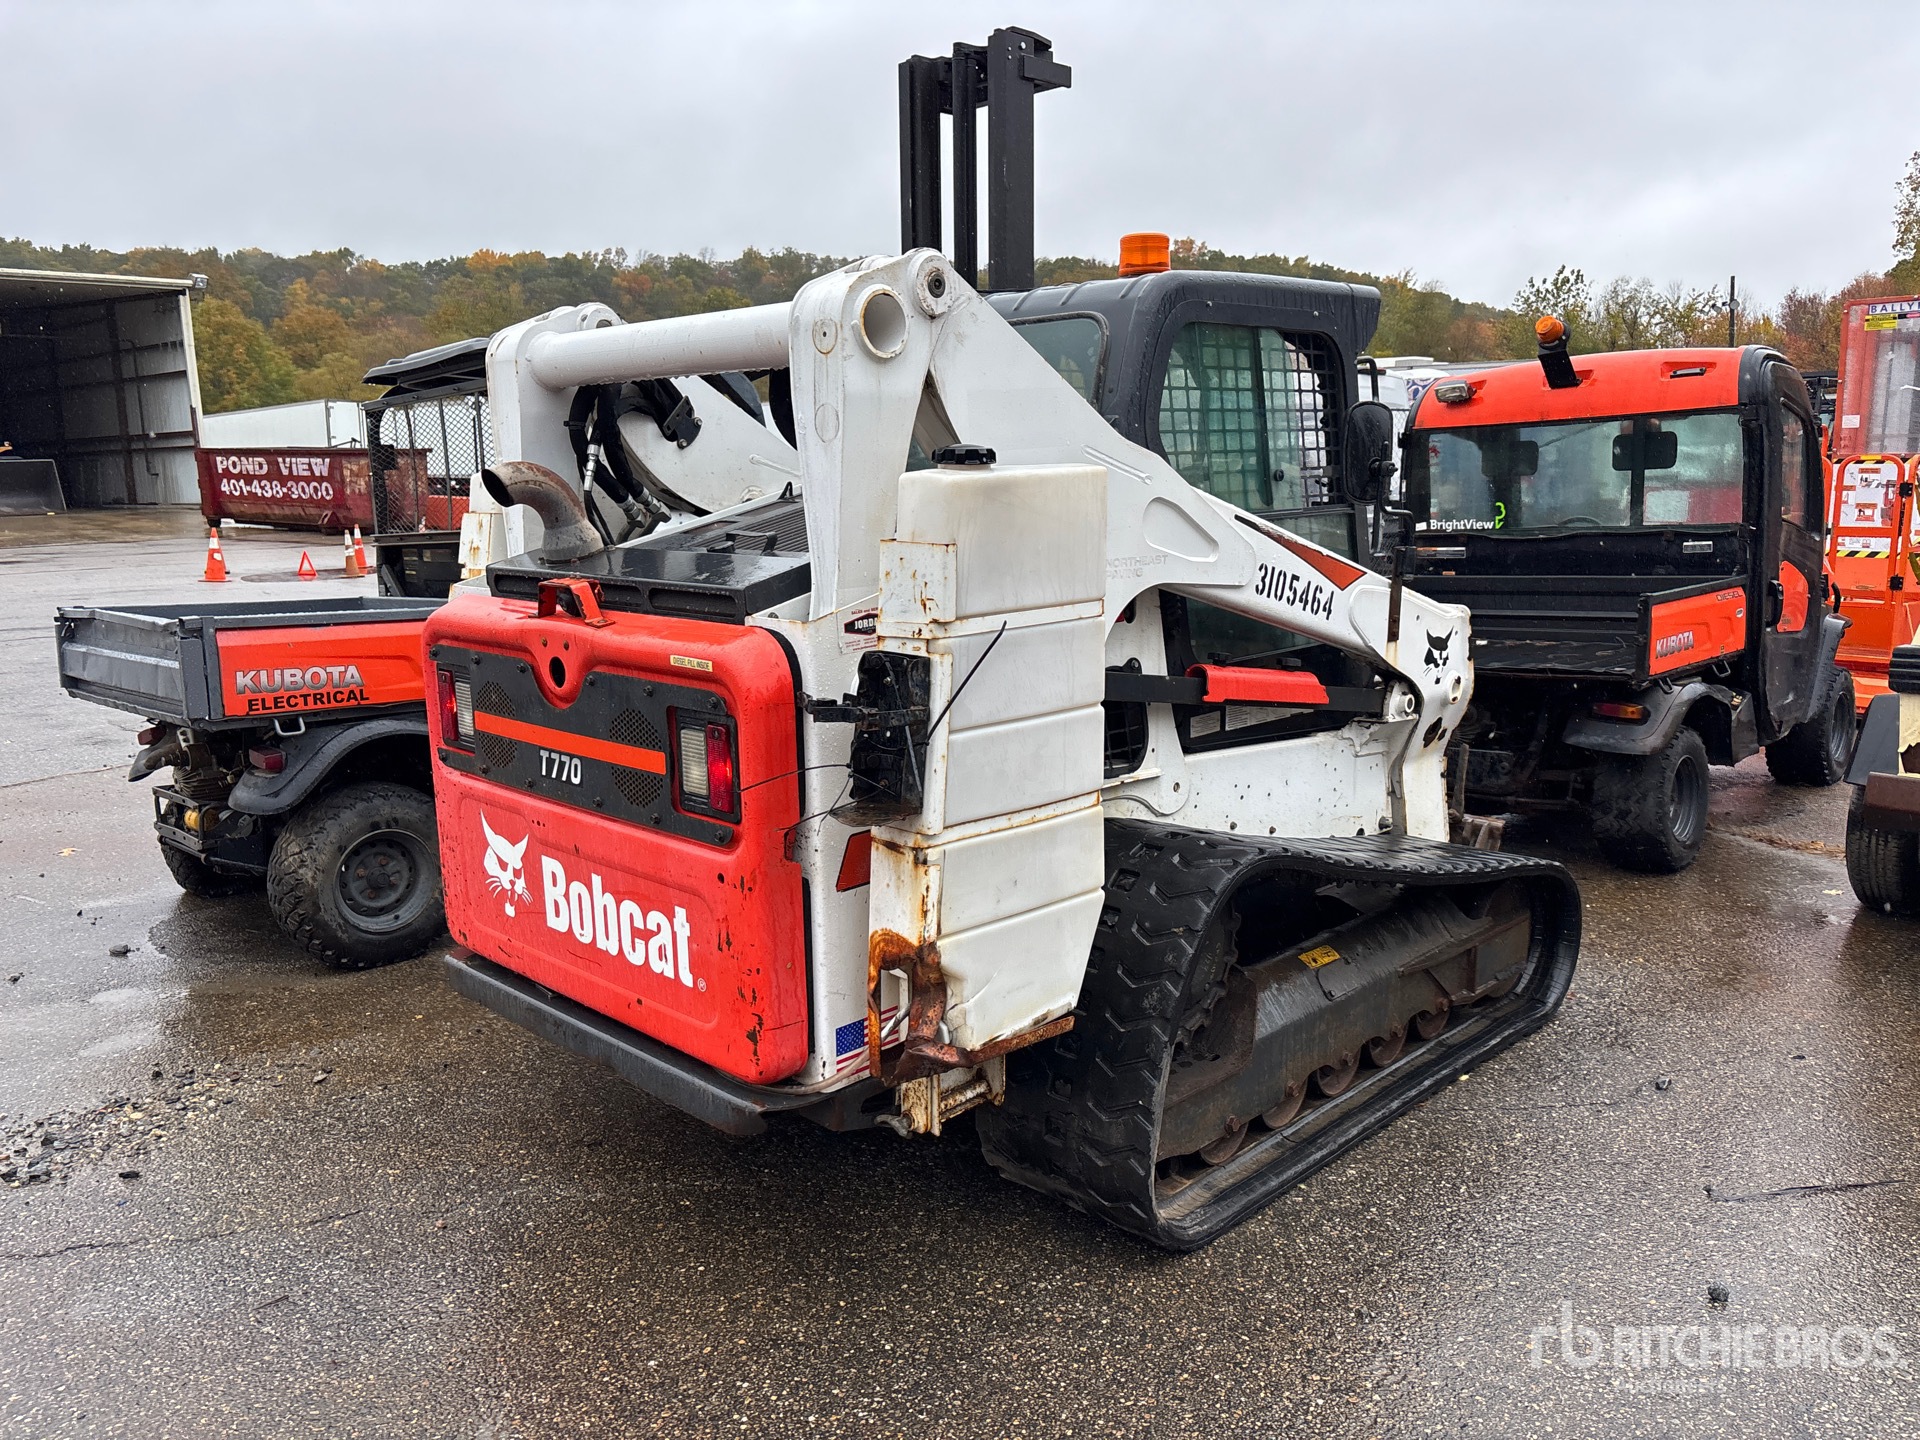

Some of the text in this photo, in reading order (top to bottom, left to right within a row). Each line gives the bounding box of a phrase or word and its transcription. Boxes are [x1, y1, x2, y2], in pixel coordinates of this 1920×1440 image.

[216, 456, 330, 476] POND VIEW
[221, 478, 334, 500] 401-438-3000
[1430, 519, 1494, 532] BrightView
[1106, 554, 1169, 568] NORTHEAST
[1255, 563, 1334, 621] 3105464
[1716, 591, 1743, 602] DIESEL
[1655, 631, 1694, 659] KUBOTA
[236, 665, 364, 694] KUBOTA
[247, 689, 370, 712] ELECTRICAL
[540, 749, 582, 785] T770
[541, 854, 694, 988] Bobcat
